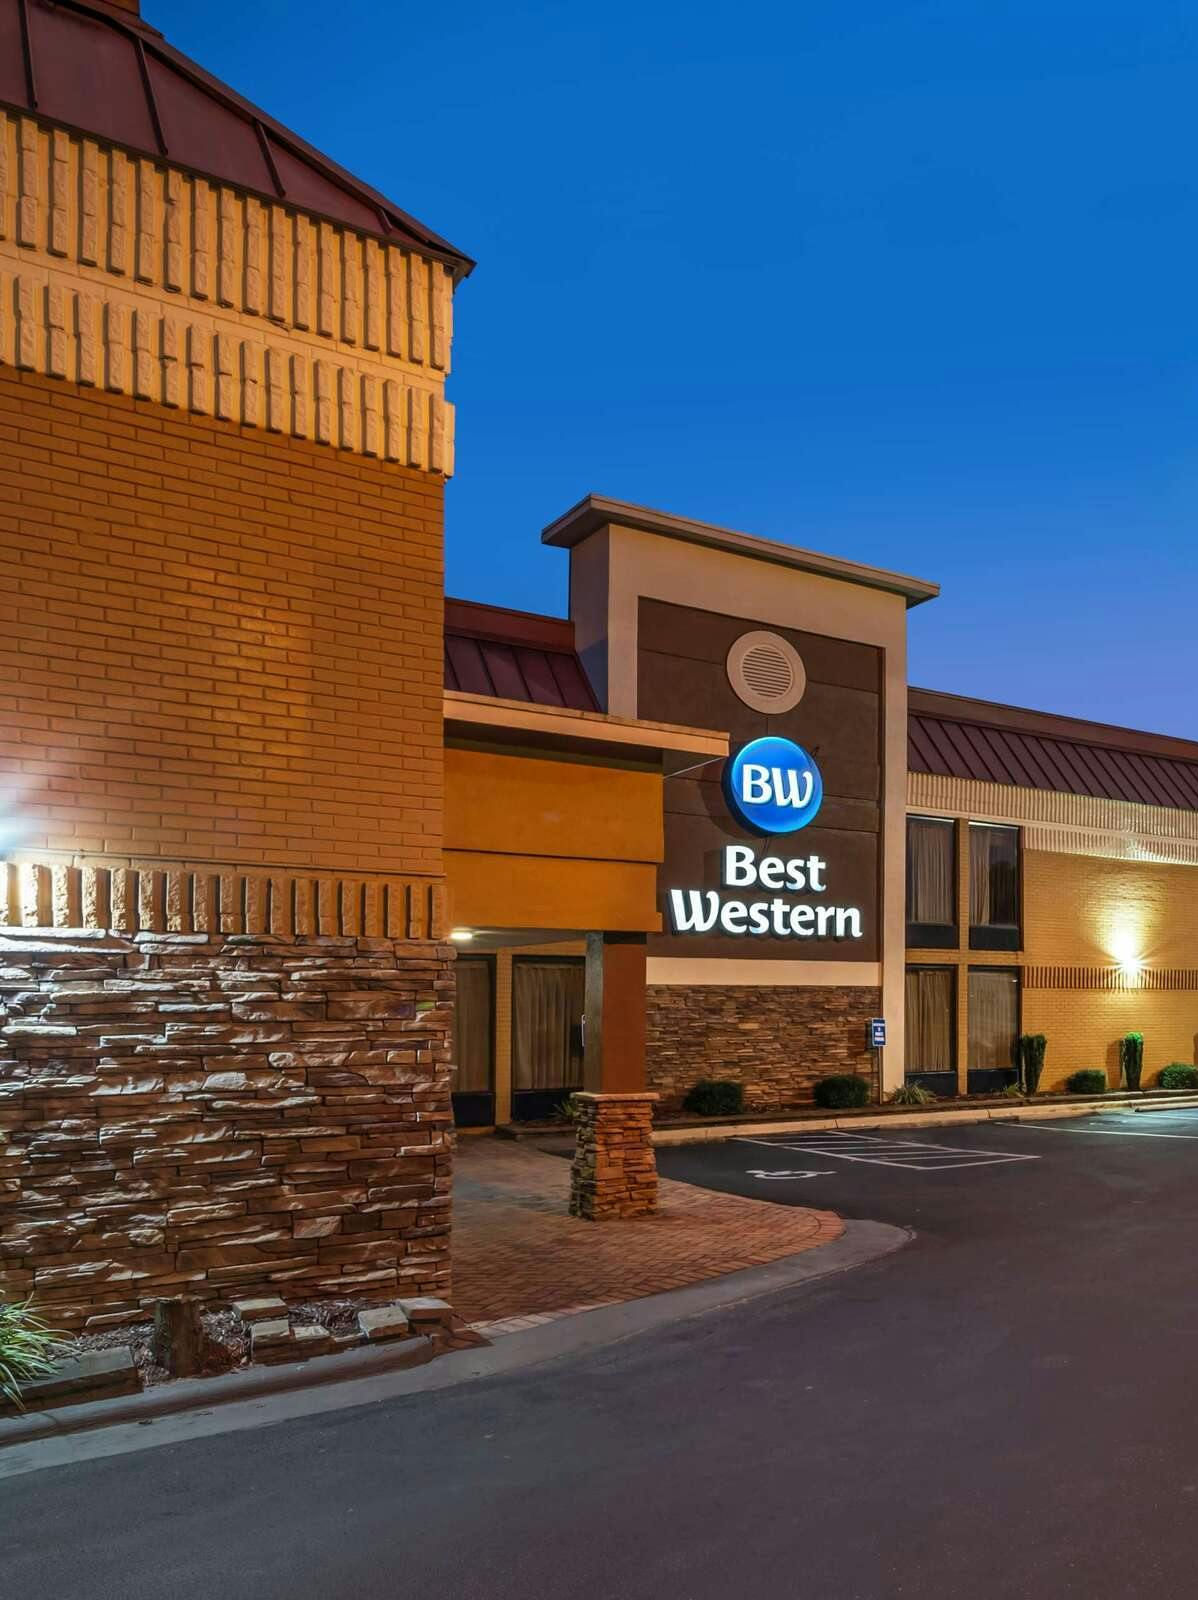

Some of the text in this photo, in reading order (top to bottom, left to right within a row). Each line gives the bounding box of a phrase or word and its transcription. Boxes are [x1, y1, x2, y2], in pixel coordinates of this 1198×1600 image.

[742, 764, 812, 808] BW
[725, 845, 827, 891] Best
[670, 889, 863, 938] Western
